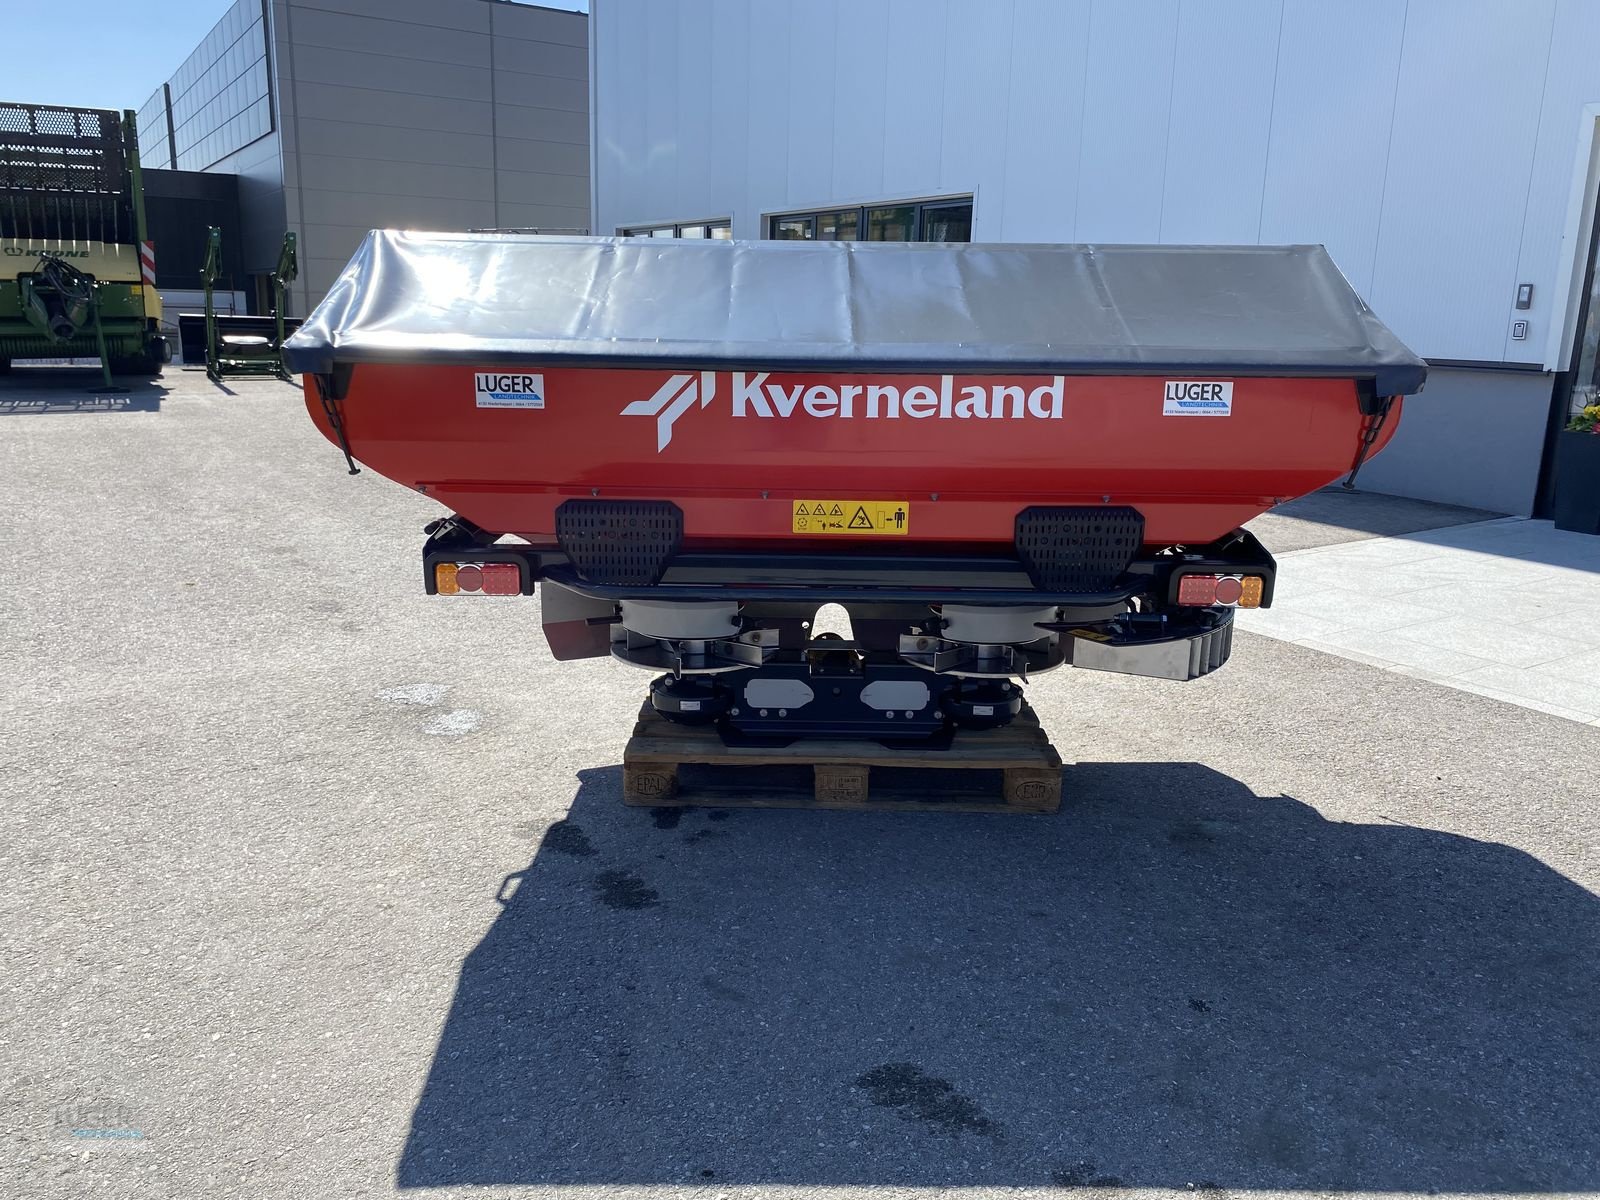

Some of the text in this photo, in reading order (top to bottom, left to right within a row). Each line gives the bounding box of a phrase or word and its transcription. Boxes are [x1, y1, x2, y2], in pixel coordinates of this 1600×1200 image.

[25, 249, 89, 257] KRONE
[477, 375, 536, 393] LUGER
[1166, 383, 1223, 401] LUGER
[732, 371, 1065, 419] Kverneland
[637, 777, 663, 791] EPAL
